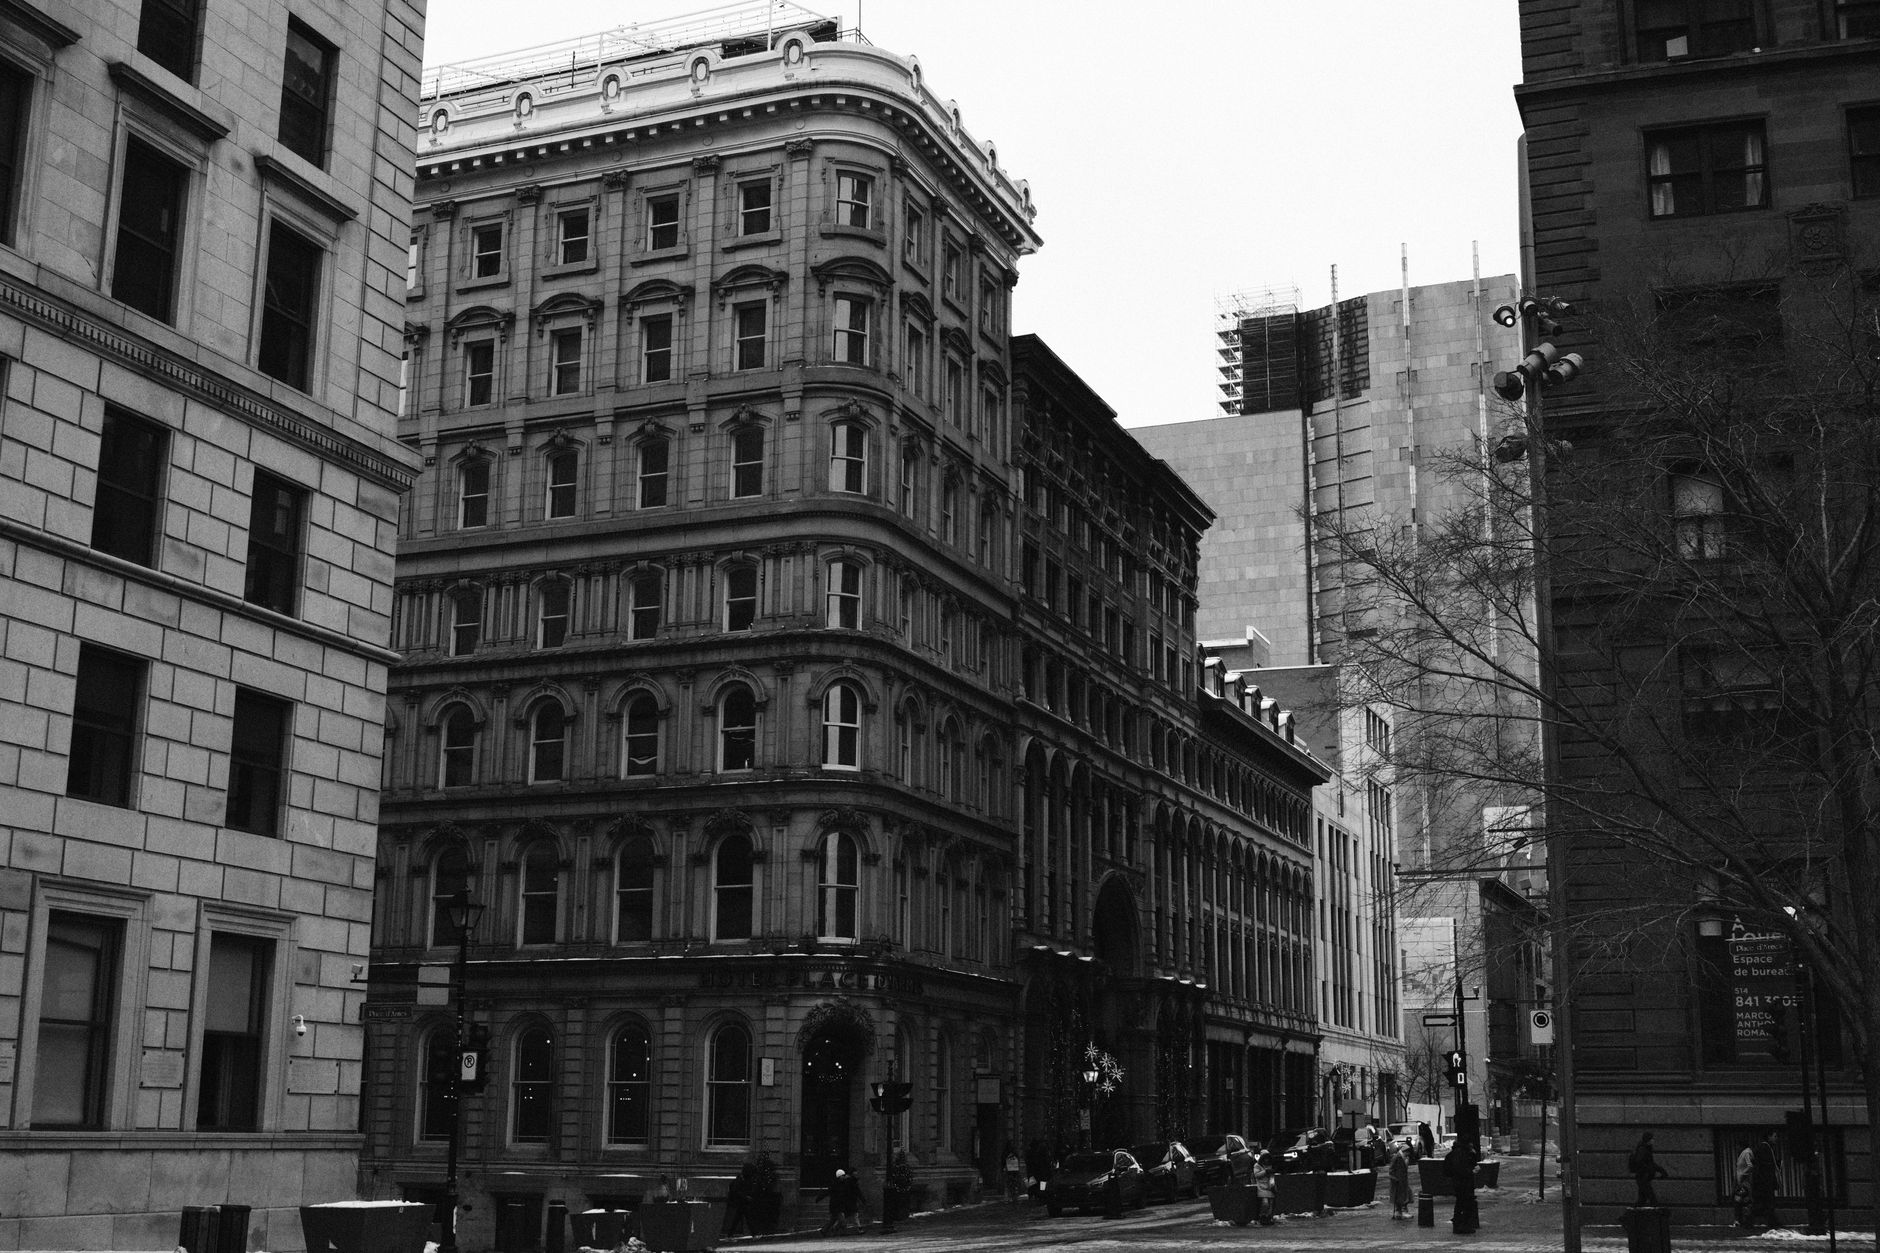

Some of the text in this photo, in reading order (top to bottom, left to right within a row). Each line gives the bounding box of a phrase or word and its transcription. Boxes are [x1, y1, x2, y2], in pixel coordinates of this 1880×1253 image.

[1733, 955, 1773, 966] Espace
[1734, 967, 1749, 976] de
[1734, 987, 1749, 995] 514
[1735, 996, 1759, 1006] 841
[1736, 1011, 1772, 1020] MARCO
